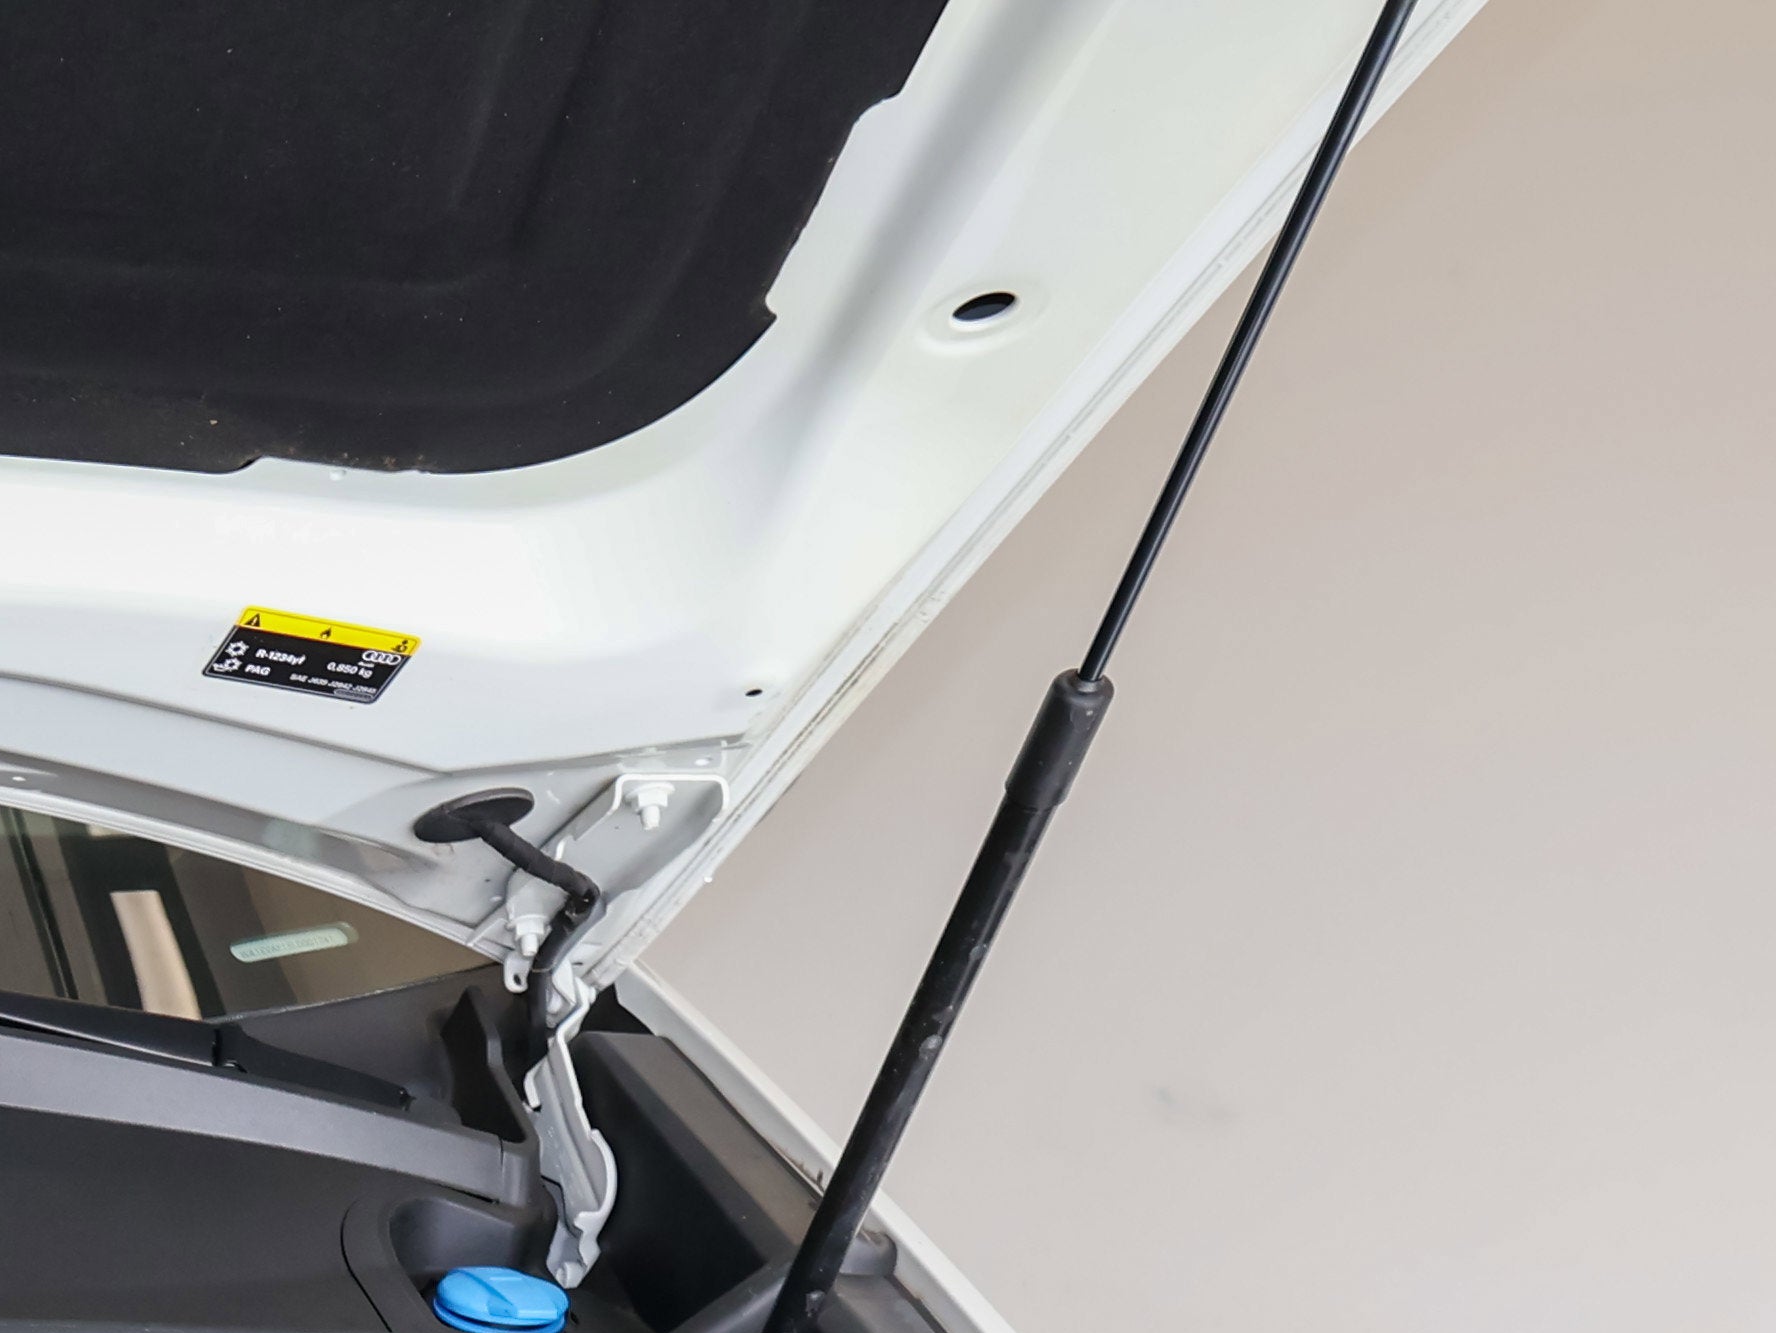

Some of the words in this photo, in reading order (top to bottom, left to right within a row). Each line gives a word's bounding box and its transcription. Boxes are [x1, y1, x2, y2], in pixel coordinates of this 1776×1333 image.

[255, 649, 306, 665] R-1234yf
[245, 664, 270, 676] PAG
[358, 668, 373, 679] kg
